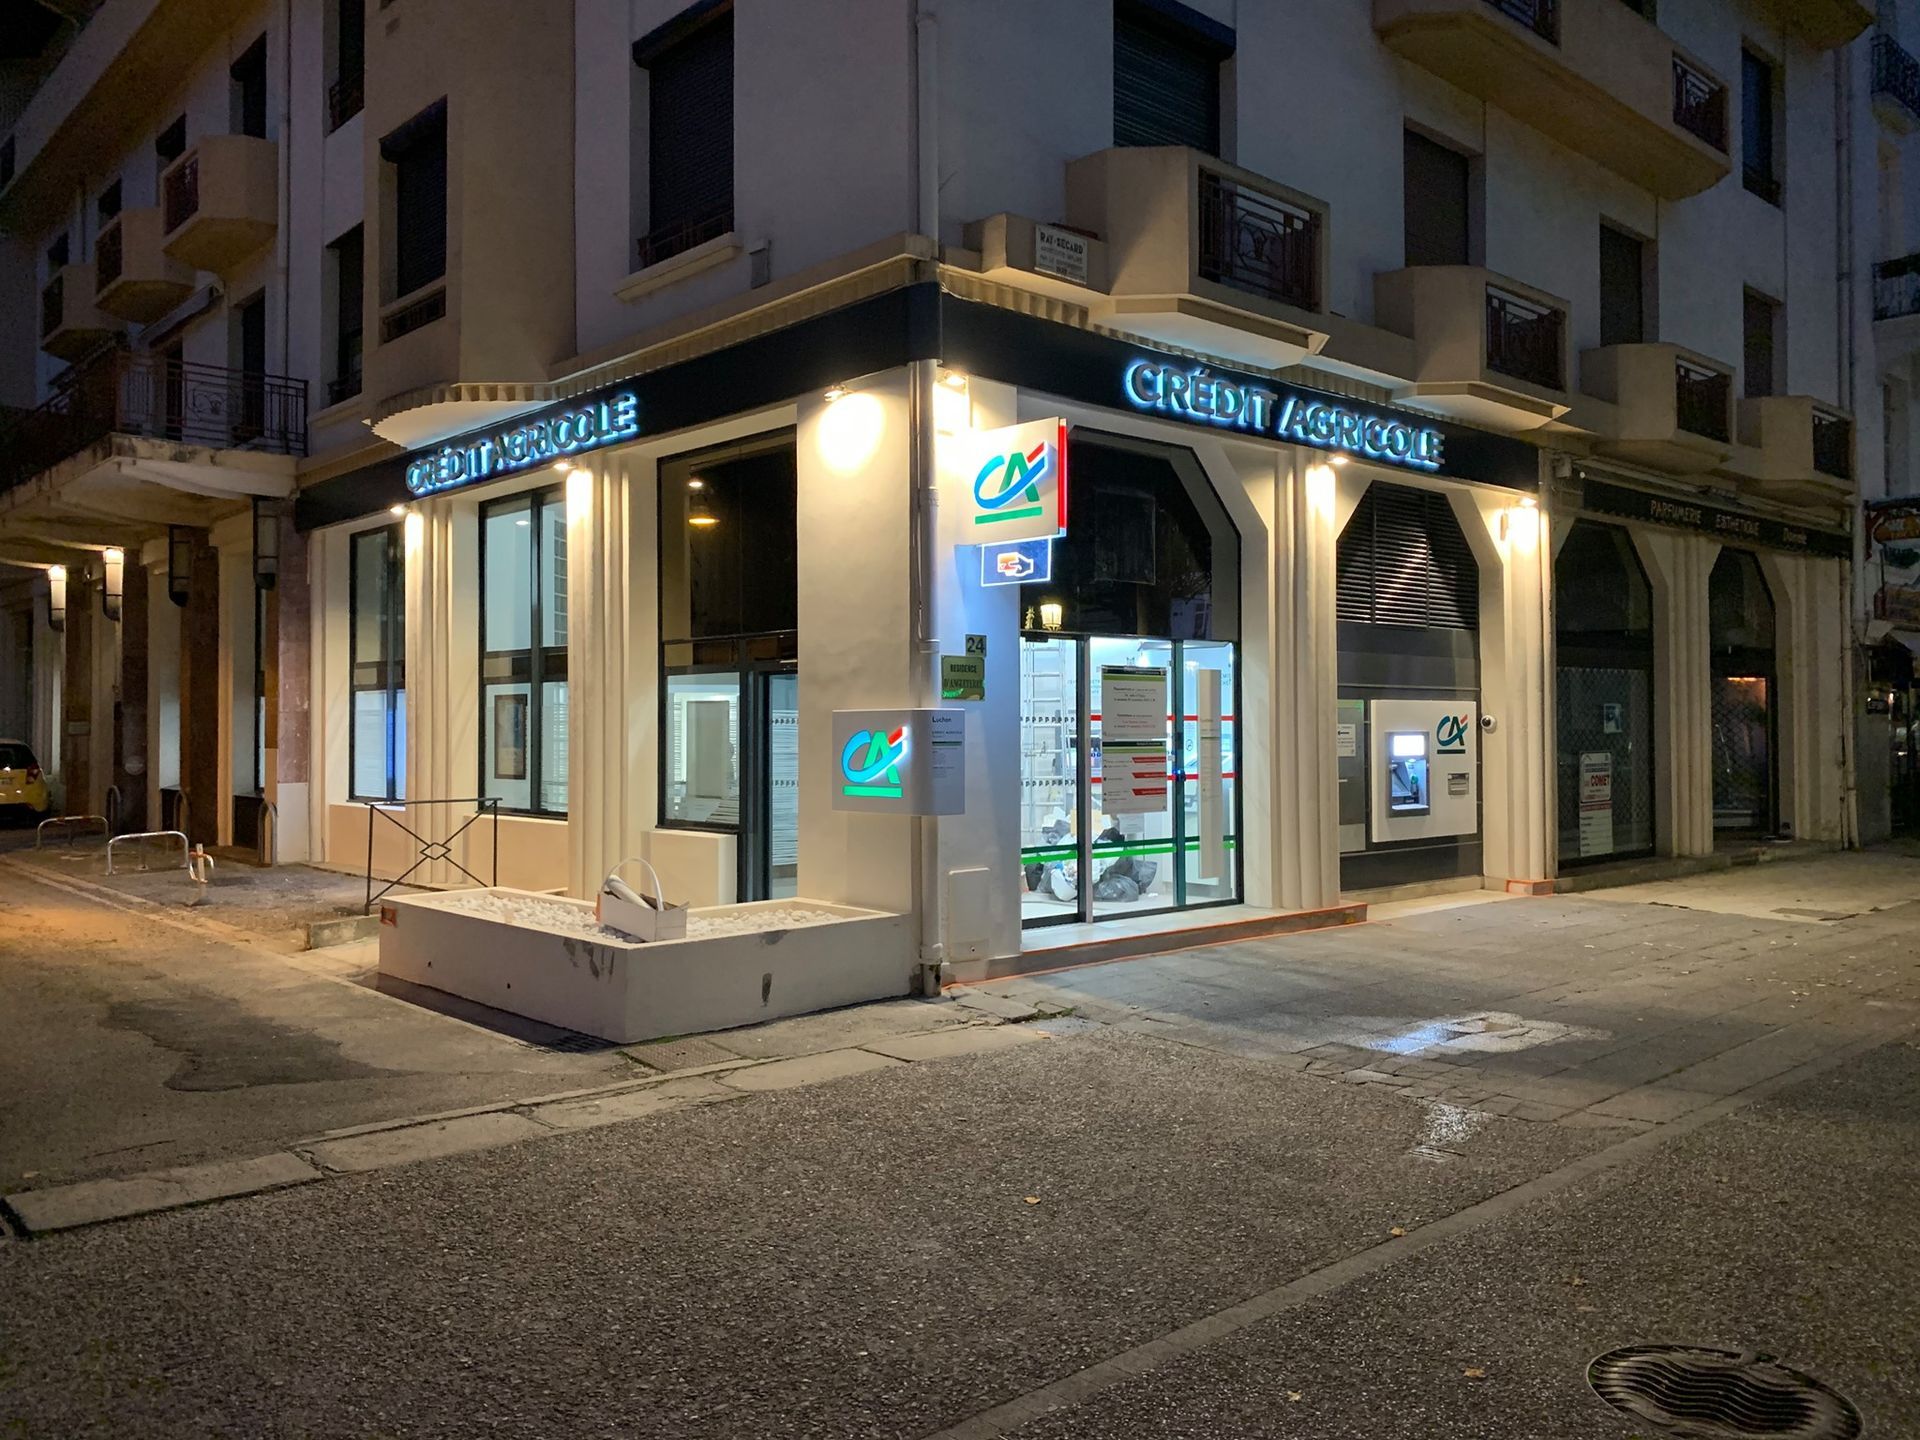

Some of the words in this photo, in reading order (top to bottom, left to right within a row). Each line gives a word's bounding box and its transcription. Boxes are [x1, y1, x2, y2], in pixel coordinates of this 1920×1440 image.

[405, 437, 493, 495] CRÉDIT
[491, 393, 640, 468] AGRICOLE
[1127, 362, 1278, 428] CRÉDIT
[1279, 399, 1446, 468] AGRICOLE
[967, 636, 985, 654] 24
